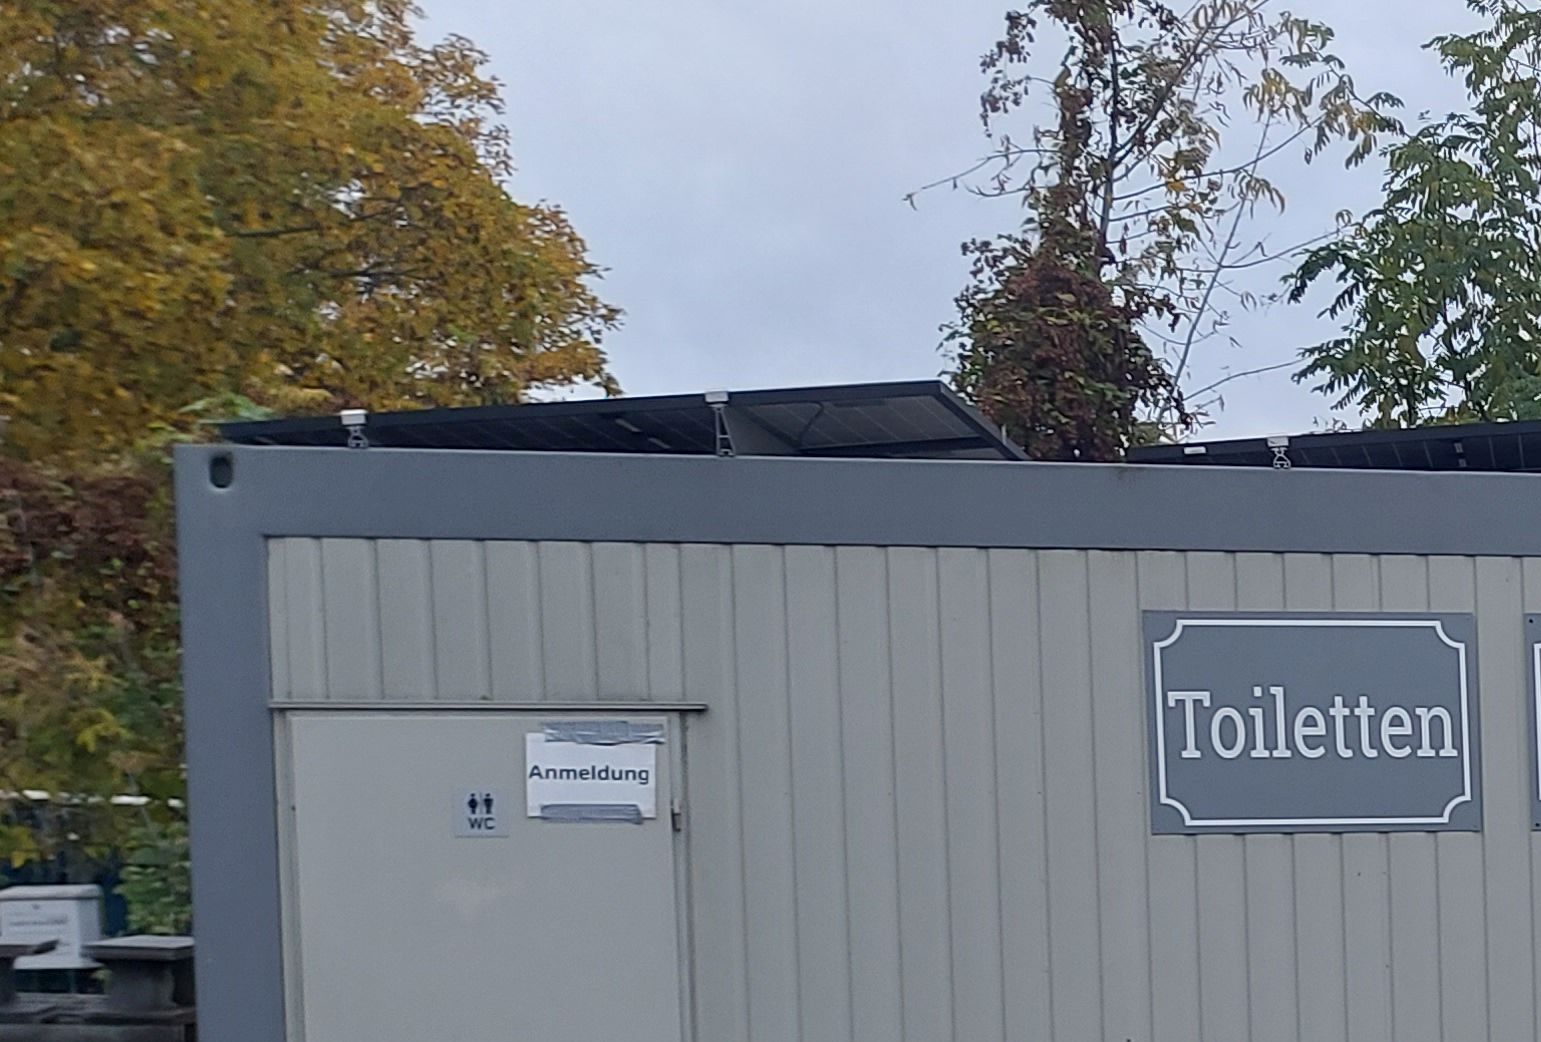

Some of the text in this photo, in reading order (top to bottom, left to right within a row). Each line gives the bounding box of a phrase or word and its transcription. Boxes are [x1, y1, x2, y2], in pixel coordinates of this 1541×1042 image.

[1166, 686, 1458, 760] Toiletten
[528, 765, 649, 785] Anmeldung
[468, 817, 495, 830] WC
